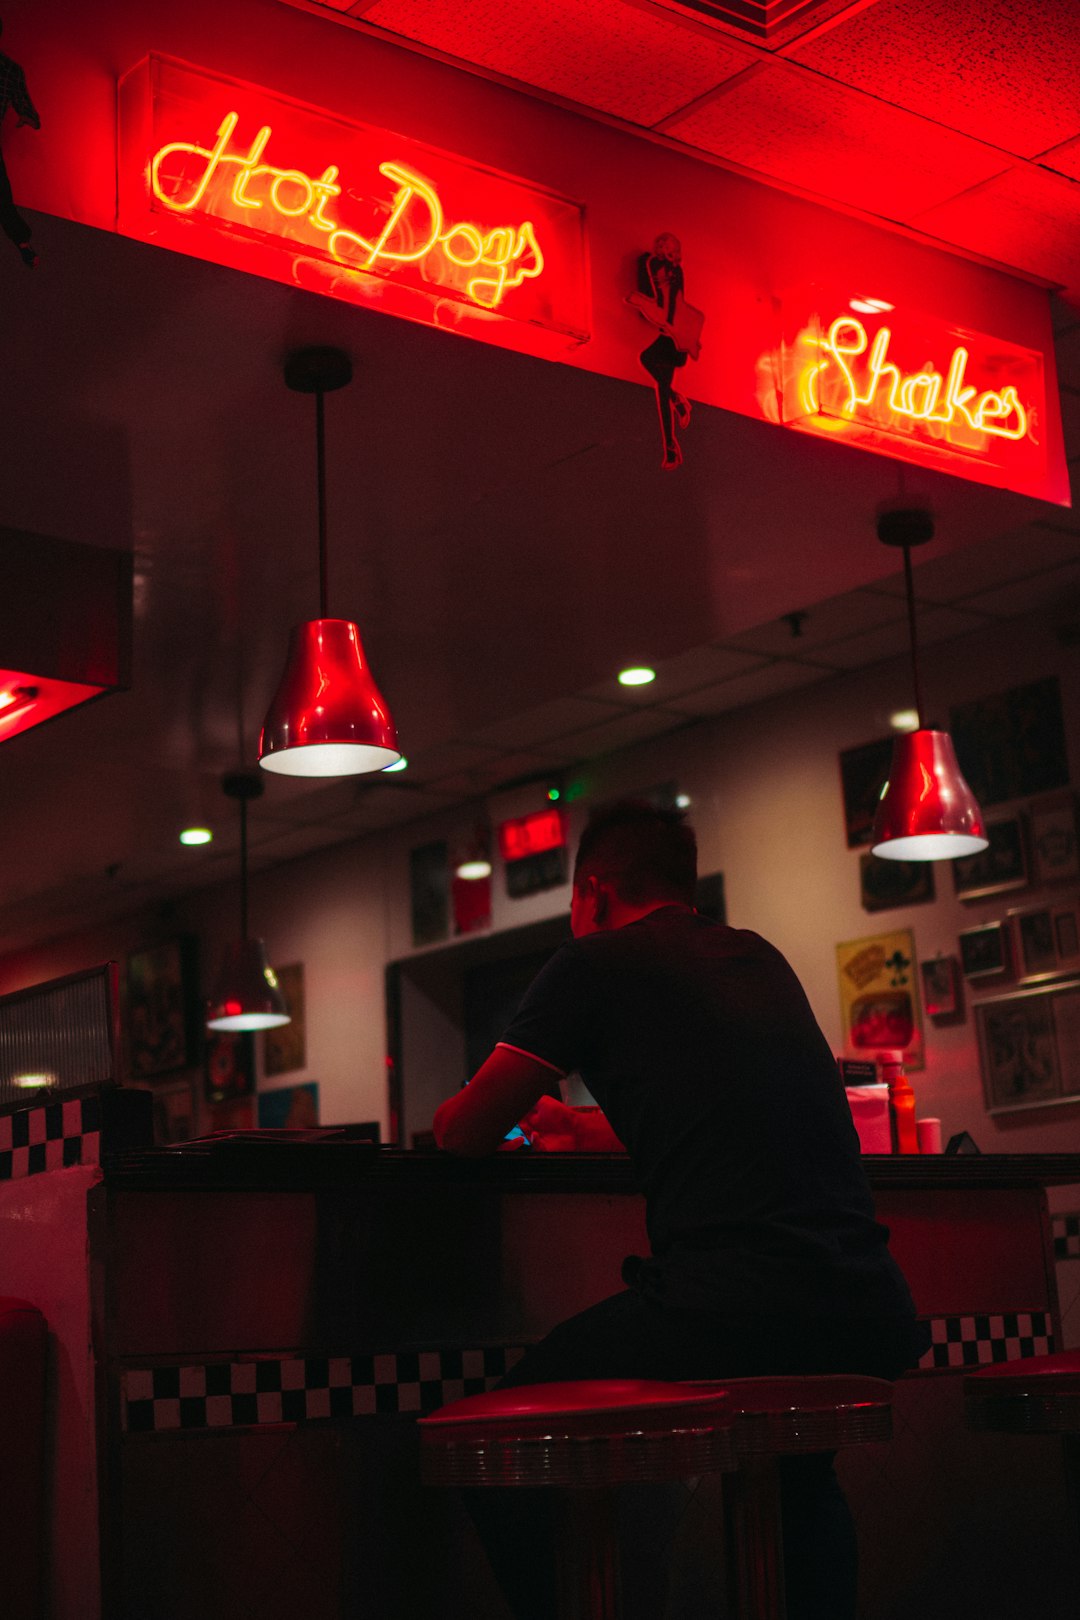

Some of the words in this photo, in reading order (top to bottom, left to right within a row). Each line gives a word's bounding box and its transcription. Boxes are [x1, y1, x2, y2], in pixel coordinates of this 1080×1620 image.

[152, 112, 339, 231] Hot
[328, 161, 545, 308] Dogs
[804, 316, 1027, 439] Shakes
